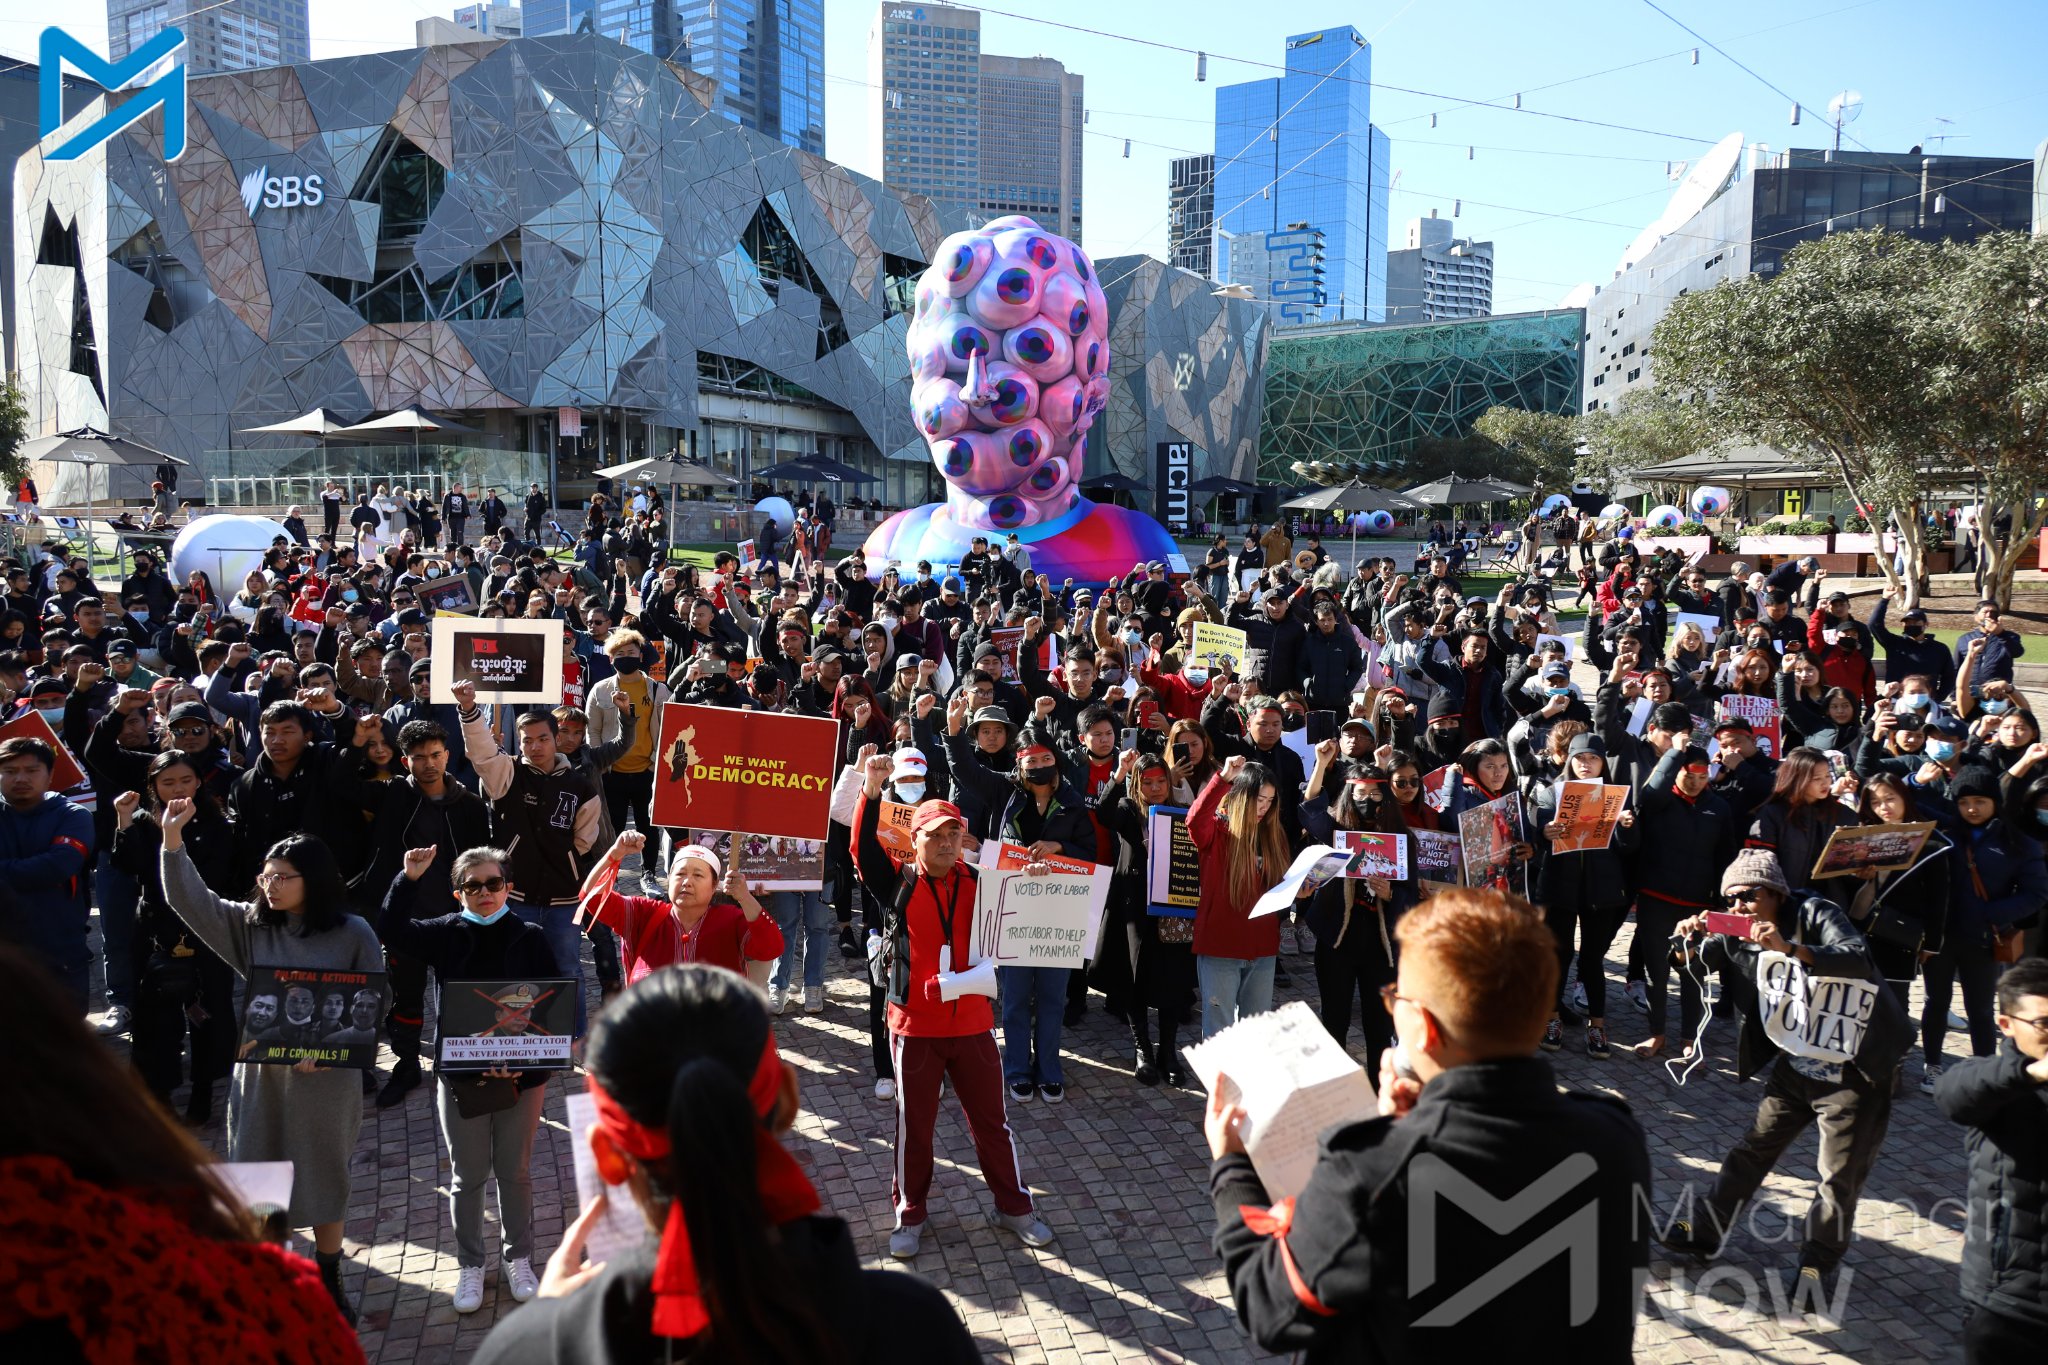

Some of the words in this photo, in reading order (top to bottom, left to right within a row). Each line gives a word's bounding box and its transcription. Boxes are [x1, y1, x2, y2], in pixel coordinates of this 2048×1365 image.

[890, 9, 913, 20] ANZ
[1287, 41, 1298, 50] EY
[264, 174, 324, 208] SBS
[1197, 636, 1228, 646] MILITARY
[1728, 696, 1775, 708] RELEASE
[1722, 706, 1740, 717] OUR
[1741, 706, 1780, 717] LEADERS
[723, 754, 744, 766] WE
[747, 757, 787, 770] WANT
[693, 764, 829, 792] DEMOCRACY
[1562, 794, 1576, 809] US
[550, 791, 579, 829] A
[893, 807, 913, 821] HE
[891, 818, 911, 828] SAVE
[1425, 841, 1442, 851] WILL
[886, 847, 914, 859] STOP
[1007, 850, 1033, 862] SAVE
[1427, 850, 1442, 859] NOT
[1417, 856, 1449, 868] SILENCED
[1014, 882, 1043, 897] VOTED
[1045, 882, 1063, 895] FOR
[1064, 884, 1090, 896] LABOR
[979, 874, 1023, 960] WE
[1006, 927, 1029, 939] TRUST
[1029, 926, 1052, 940] LABOR
[1054, 928, 1065, 940] TO
[1065, 929, 1086, 942] HELP
[1029, 944, 1080, 958] MYANMAR
[273, 970, 318, 982] POLITICAL
[321, 972, 367, 984] ACTIVISTS
[1766, 961, 1877, 1024] GENTLE
[446, 1039, 478, 1047] SHAME
[522, 1037, 567, 1045] DICTATOR
[268, 1047, 285, 1058] NOT
[289, 1047, 338, 1061] CRIMINALS
[450, 1050, 465, 1058] WE
[468, 1050, 499, 1058] NEVER
[500, 1049, 539, 1057] FORGIVE
[543, 1048, 562, 1056] YOU
